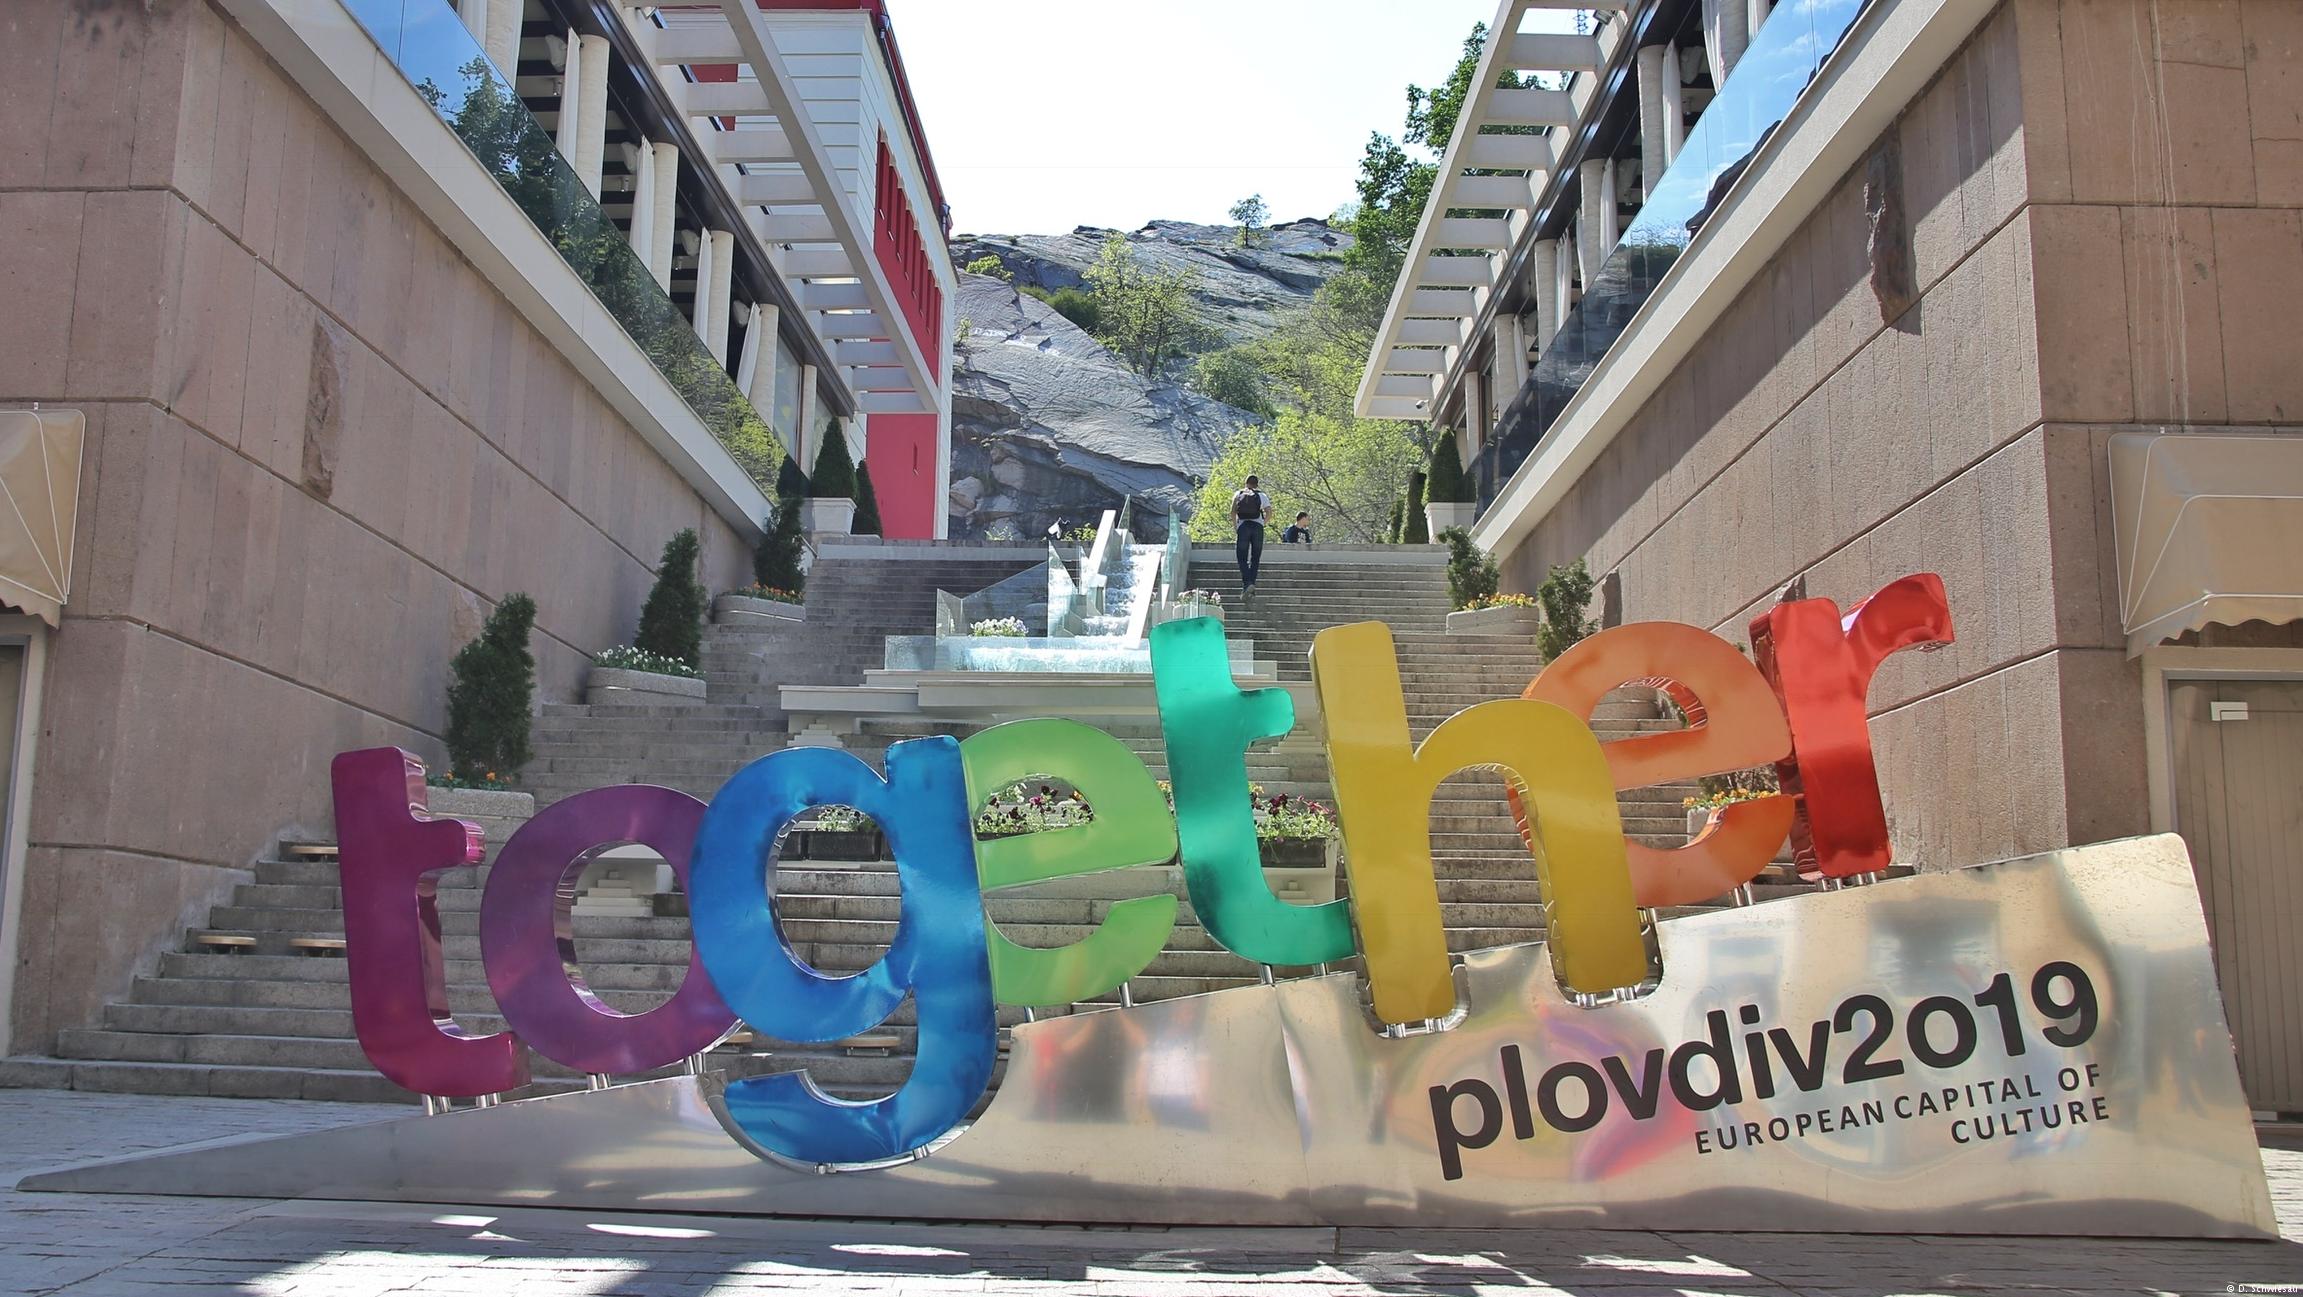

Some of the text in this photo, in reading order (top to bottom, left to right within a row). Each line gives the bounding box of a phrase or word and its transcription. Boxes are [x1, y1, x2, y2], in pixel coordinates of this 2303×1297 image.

[331, 572, 1955, 1172] together
[1695, 1063, 2101, 1154] EUROPEAN CAPITAL OF
[1951, 1096, 2110, 1144] CULTURE
